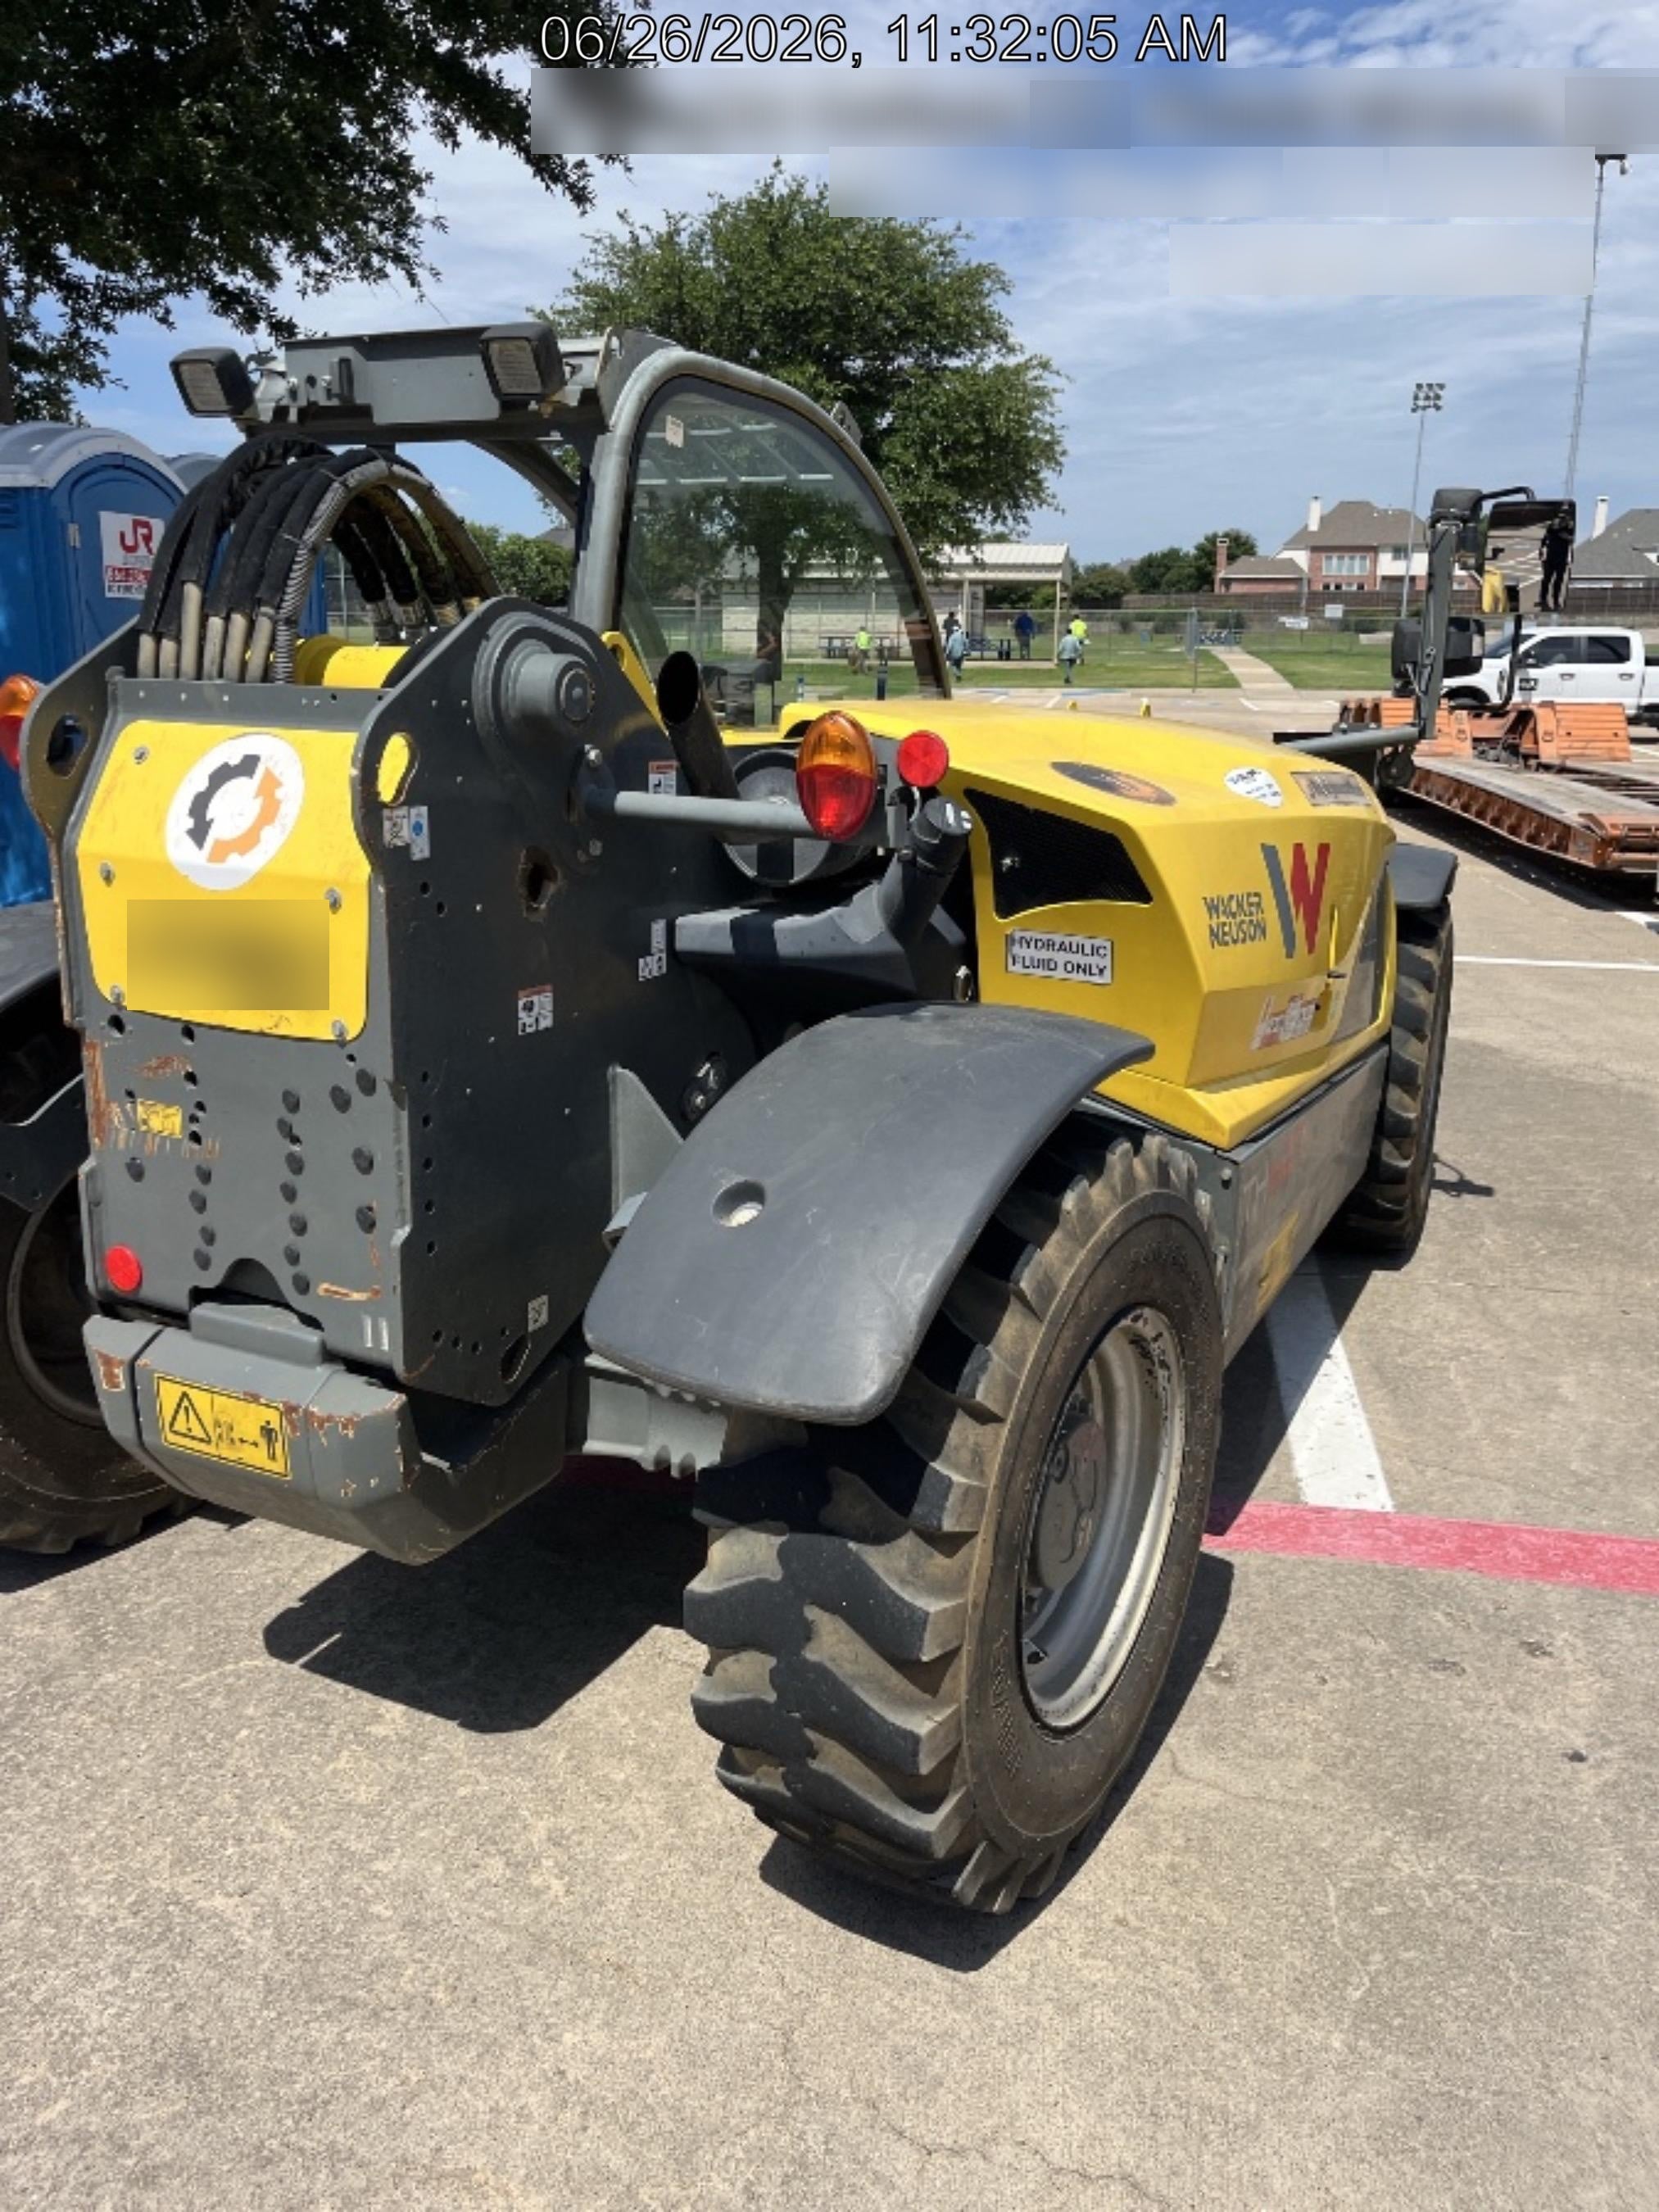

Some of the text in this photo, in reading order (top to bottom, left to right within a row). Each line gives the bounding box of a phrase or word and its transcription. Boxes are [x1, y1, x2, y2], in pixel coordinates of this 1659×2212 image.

[119, 518, 153, 555] JR
[1202, 892, 1264, 920] WACKER
[1009, 936, 1107, 959] HYDRAULIC
[1208, 918, 1267, 950] NEUSON
[1011, 954, 1107, 977] FLUID ONLY
